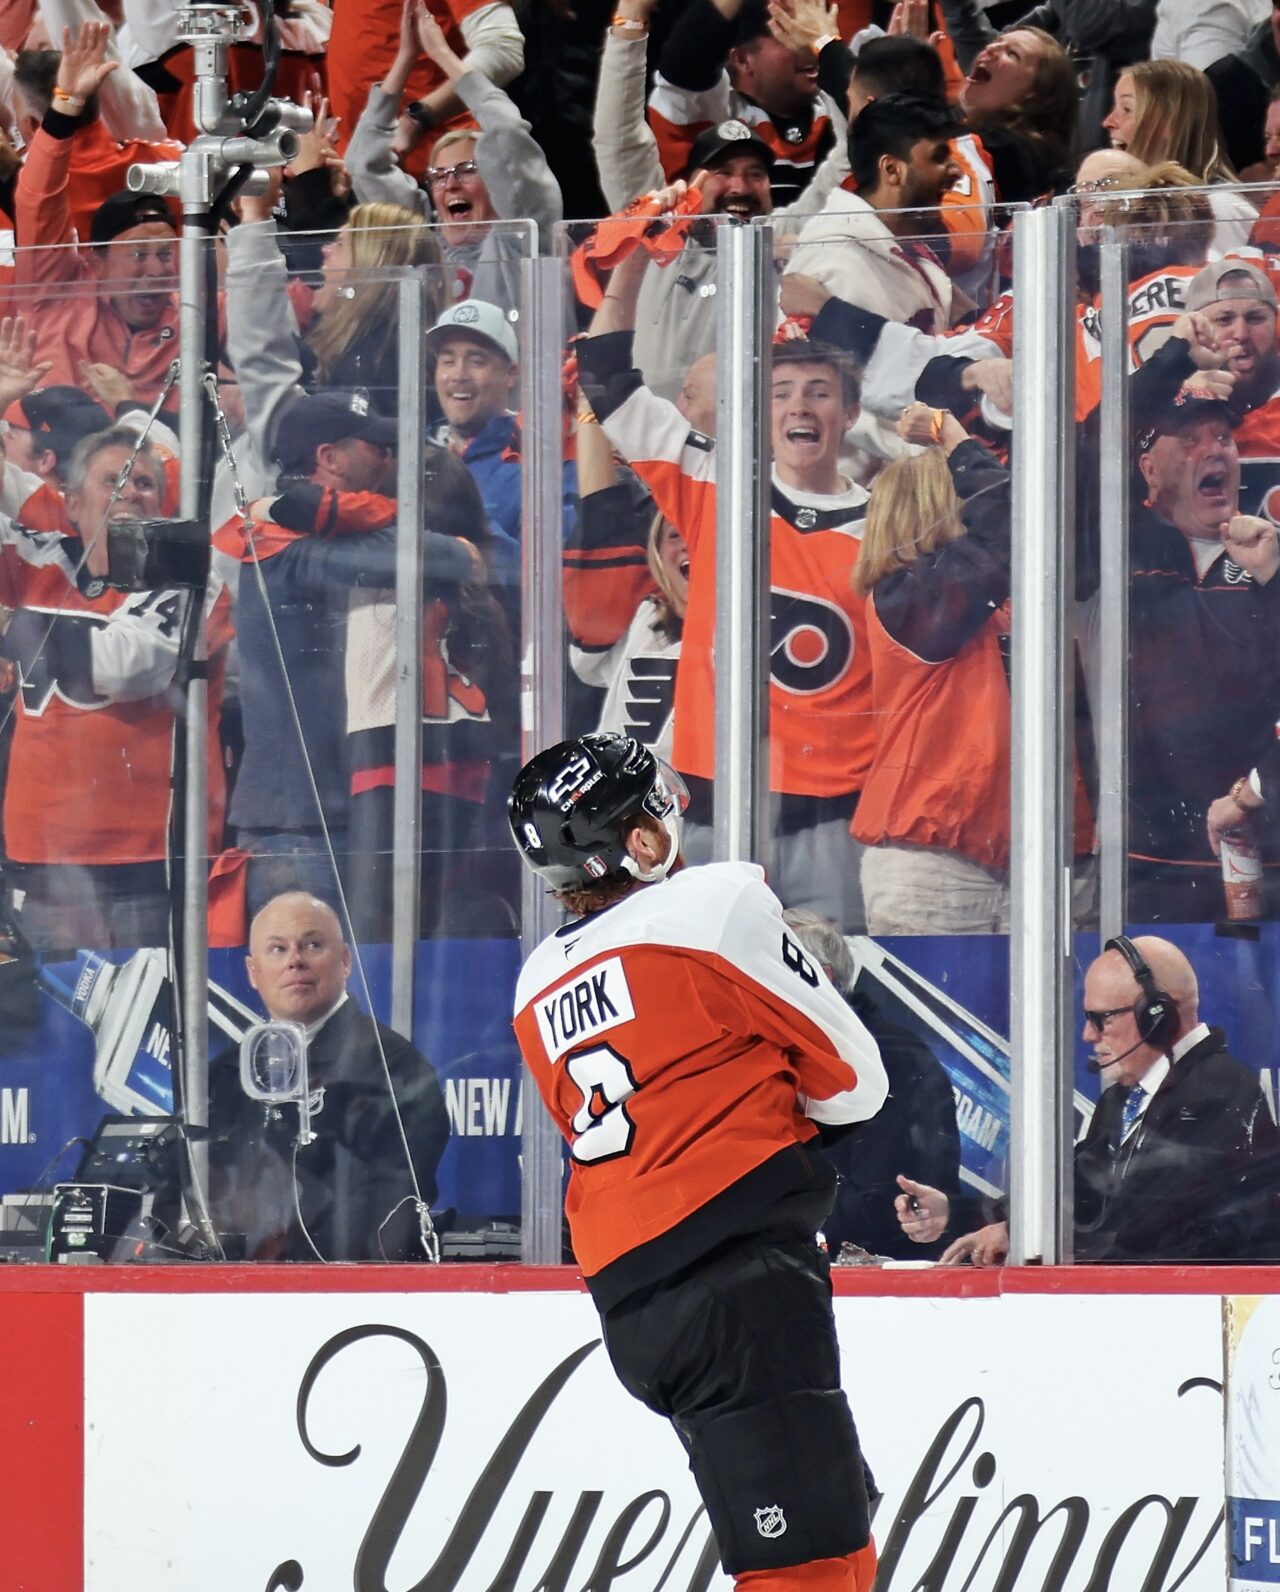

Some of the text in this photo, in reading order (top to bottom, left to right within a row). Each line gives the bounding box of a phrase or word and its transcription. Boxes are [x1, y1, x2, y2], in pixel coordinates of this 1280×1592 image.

[560, 769, 604, 813] CHEVROLET
[523, 822, 542, 849] 8
[75, 966, 96, 1002] VODKA
[782, 932, 820, 988] 8
[544, 969, 620, 1050] YORK
[445, 1078, 511, 1136] NEW
